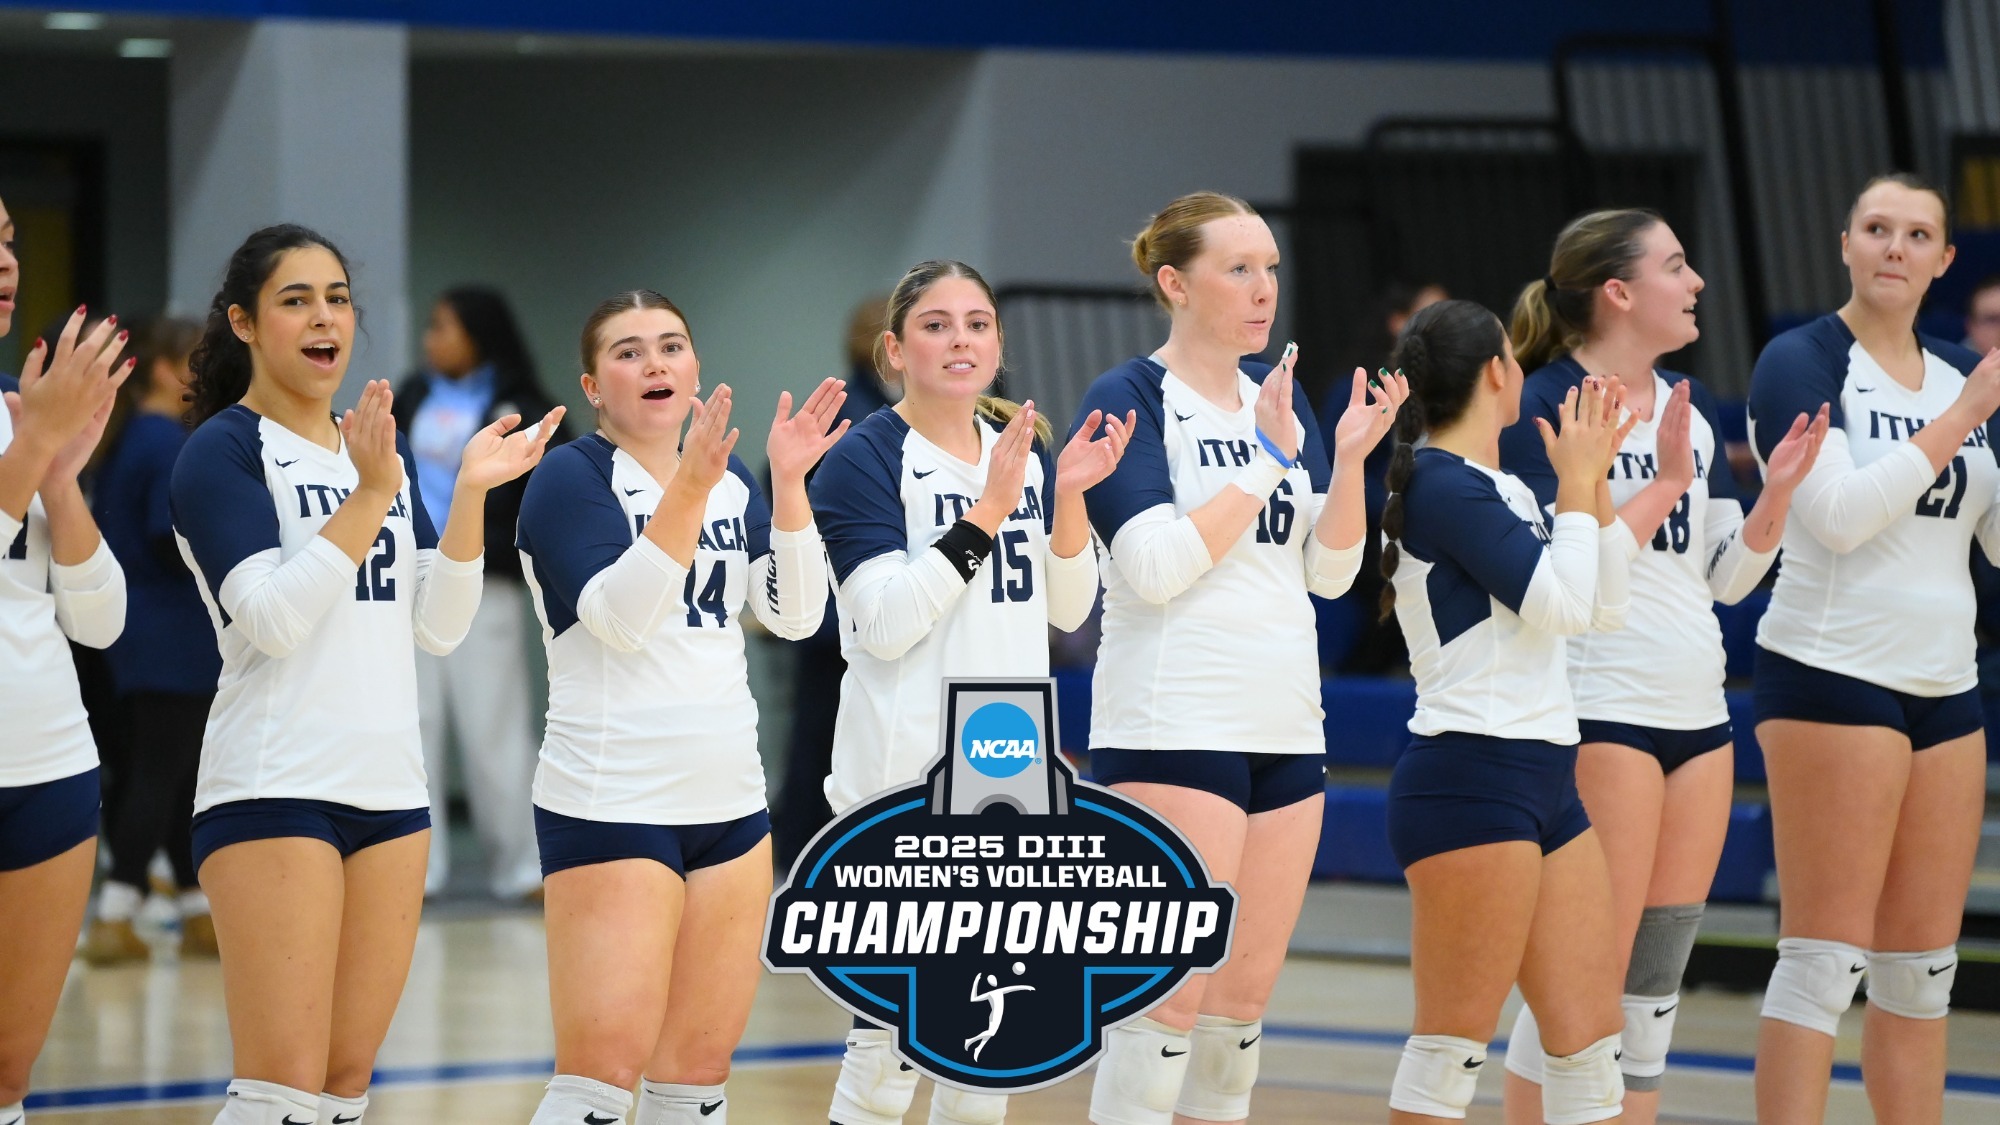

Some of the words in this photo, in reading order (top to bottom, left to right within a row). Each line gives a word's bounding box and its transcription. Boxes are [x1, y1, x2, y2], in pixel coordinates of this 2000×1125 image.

[1256, 478, 1295, 546] 16
[1915, 455, 1968, 519] 21
[355, 526, 396, 601] 12
[683, 559, 728, 628] 14
[991, 529, 1034, 603] 15
